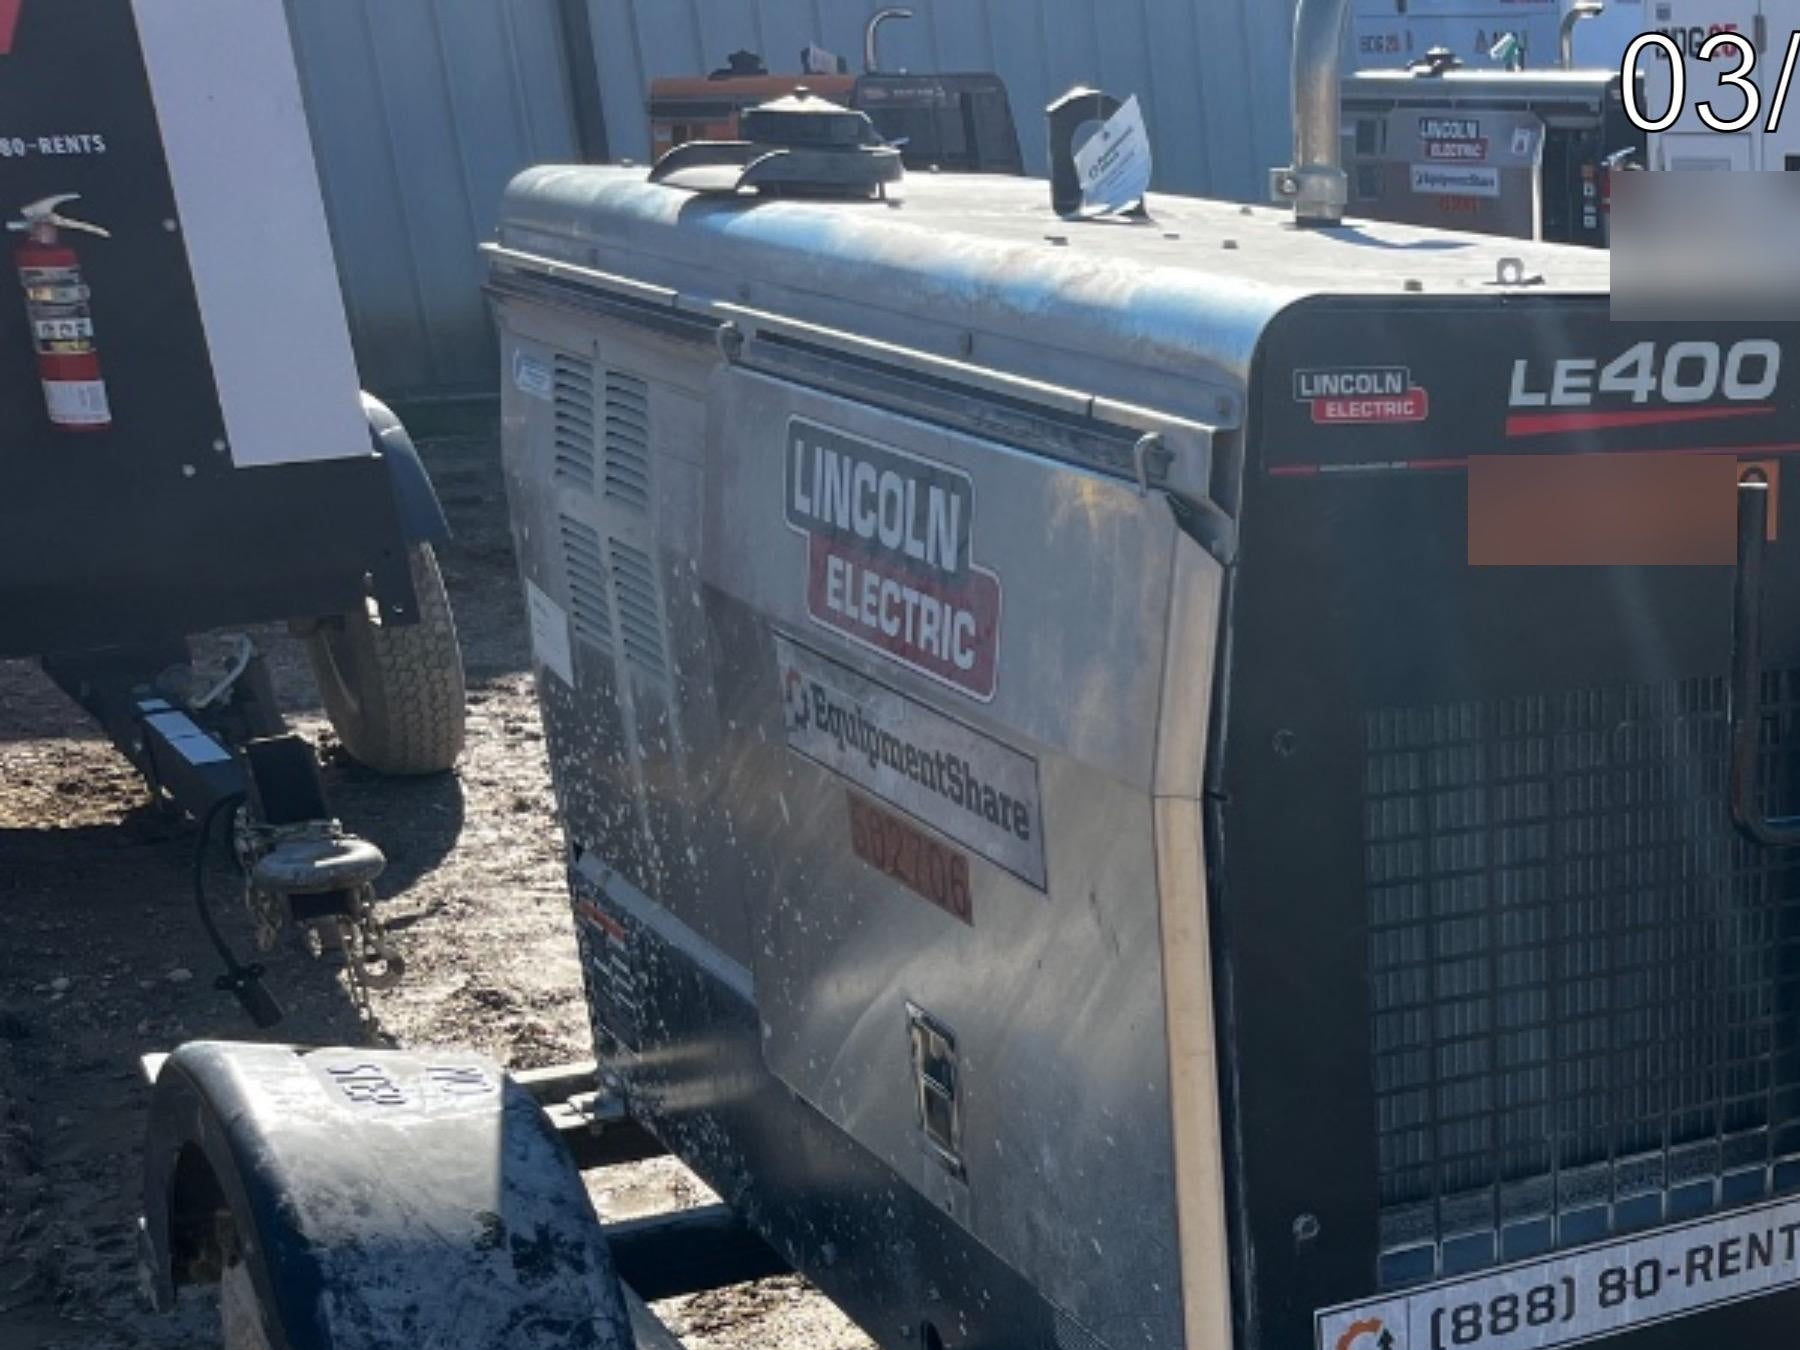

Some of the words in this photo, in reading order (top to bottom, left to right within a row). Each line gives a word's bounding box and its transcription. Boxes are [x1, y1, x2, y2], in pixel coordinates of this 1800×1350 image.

[1300, 372, 1403, 396] LINCOLN
[1325, 401, 1416, 418] ELECTRIC
[1508, 338, 1781, 406] LE400
[793, 439, 961, 573] LINCOLN
[826, 553, 976, 671] ELECTRIC
[811, 682, 1031, 841] EquipmentShare
